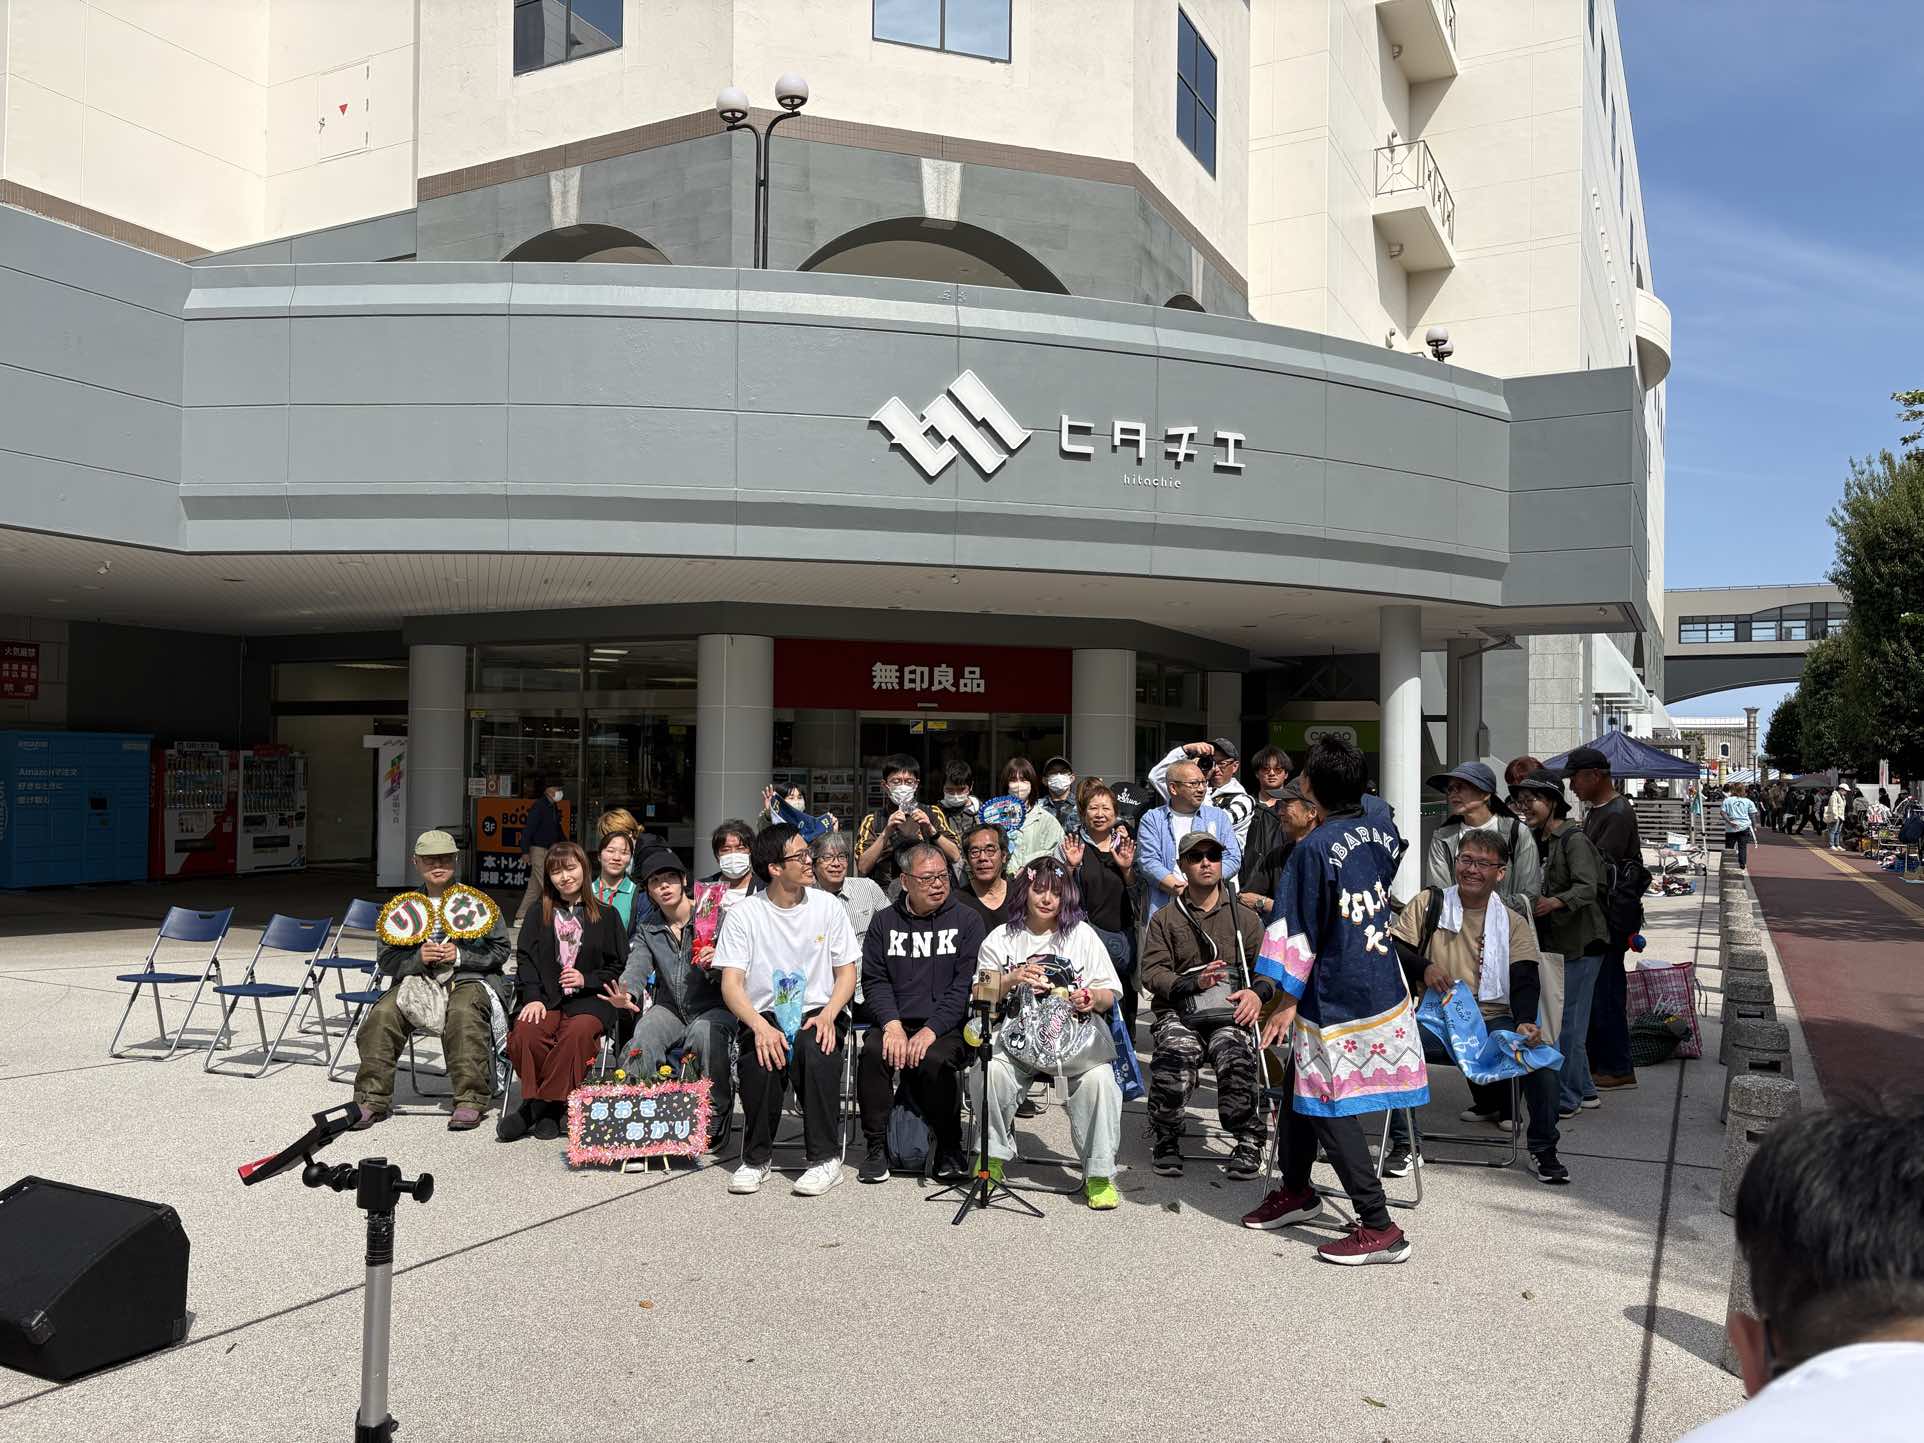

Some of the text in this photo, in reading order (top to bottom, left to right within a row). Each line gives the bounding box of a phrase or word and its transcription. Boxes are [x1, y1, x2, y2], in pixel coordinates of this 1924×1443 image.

[1061, 414, 1246, 468] ヒタチエ
[1123, 474, 1182, 488] hitachie
[871, 662, 985, 693] 無印良品
[484, 821, 496, 833] 3F
[502, 812, 528, 825] BOO
[1329, 826, 1400, 869] IBARAKI
[390, 900, 424, 937] り
[449, 894, 488, 931] な
[887, 928, 960, 959] KNK
[590, 1098, 657, 1121] あおき
[626, 1120, 690, 1141] あかり
